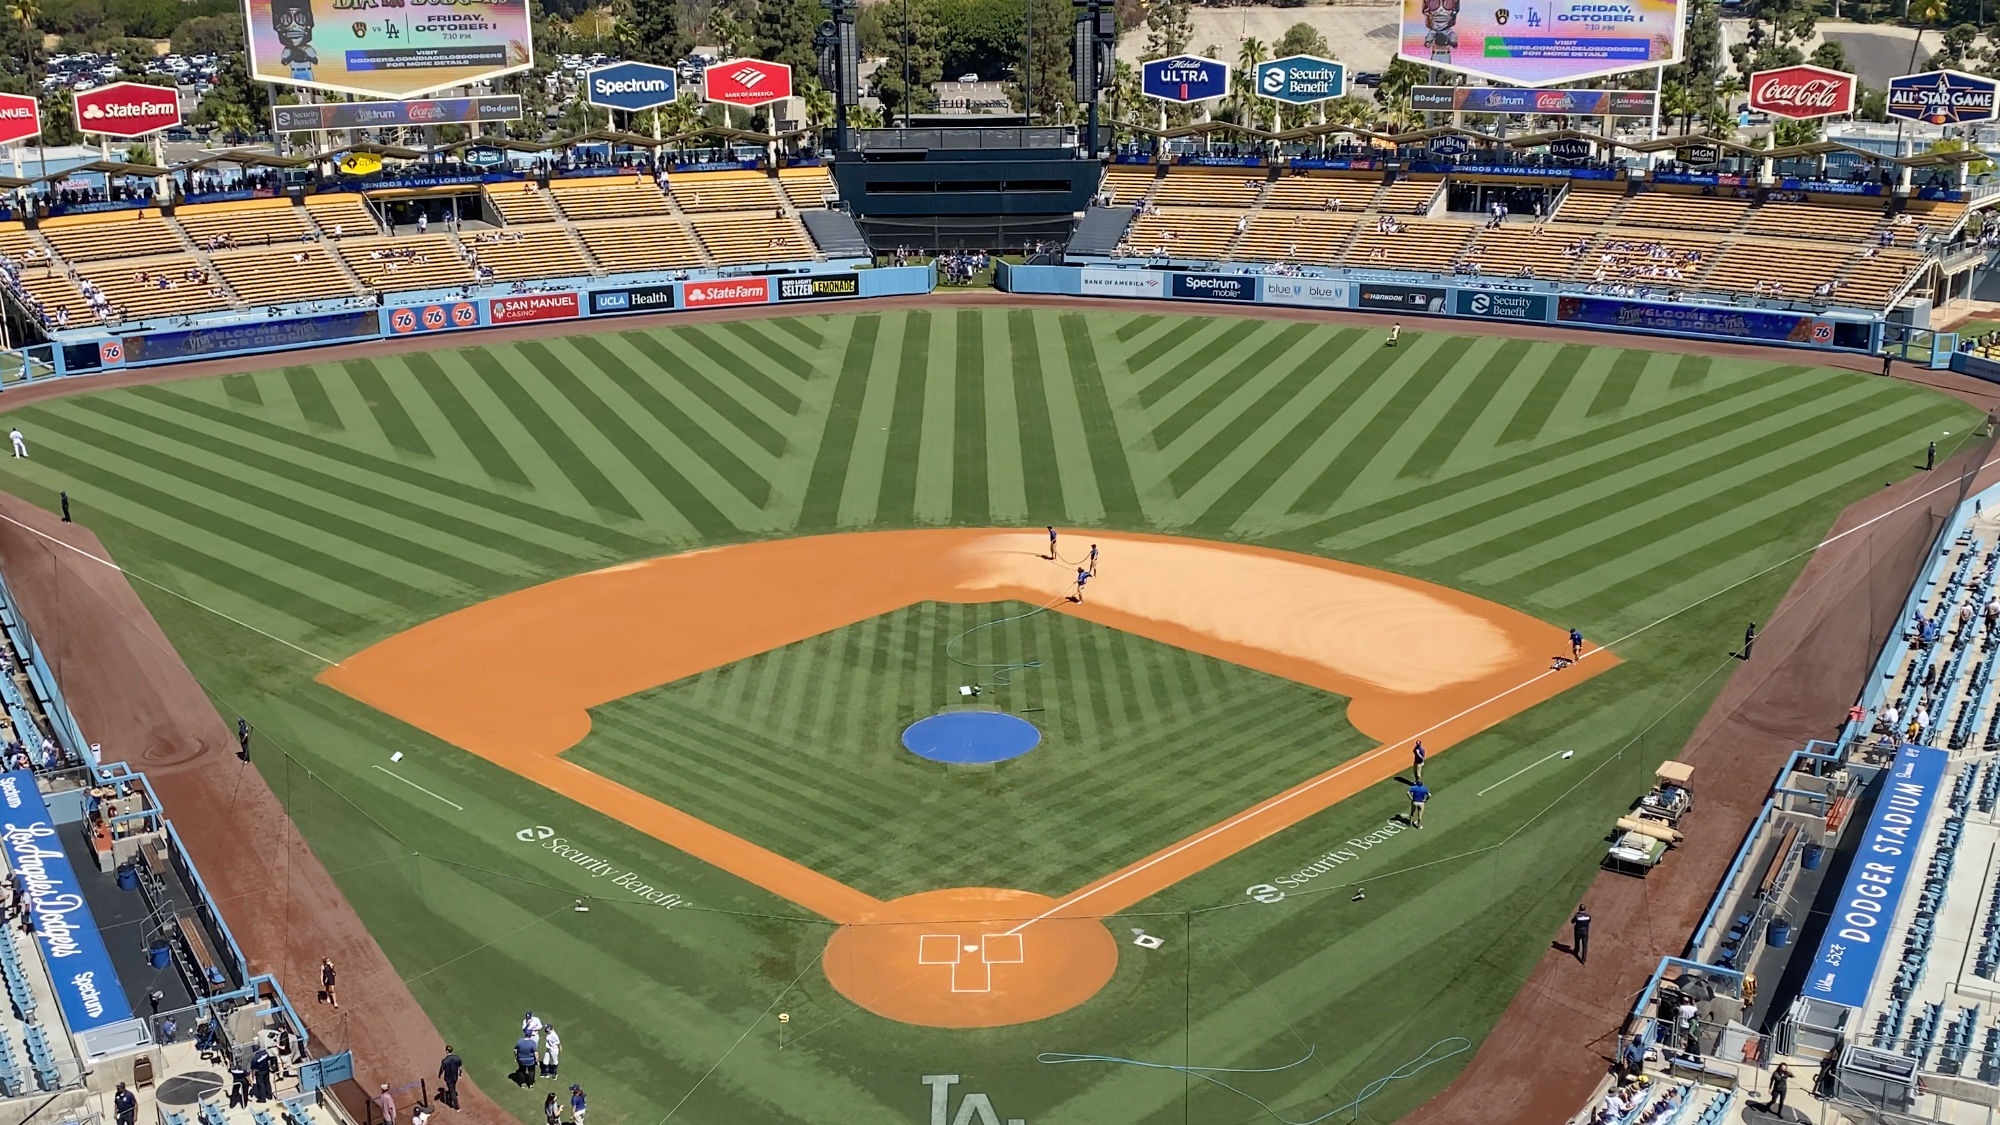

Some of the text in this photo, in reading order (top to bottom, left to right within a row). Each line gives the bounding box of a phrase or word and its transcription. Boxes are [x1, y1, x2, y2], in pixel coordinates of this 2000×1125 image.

[1571, 5, 1631, 14] FRIDAY,
[427, 14, 484, 22] FRIDAY,
[1528, 7, 1541, 27] LA
[1558, 14, 1636, 22] OCTOBER
[385, 19, 399, 38] LA
[415, 24, 488, 32] OCTOBER
[1161, 70, 1209, 82] ULTRA
[1289, 67, 1336, 86] Security
[595, 78, 664, 96] Spectrum
[1289, 80, 1328, 92] Benefit
[1414, 94, 1452, 103] @Dodgers
[1892, 91, 1992, 107] ALL STAR GAME
[480, 104, 518, 113] @Dodgers
[292, 112, 319, 122] Security
[1431, 136, 1466, 152] JIM BEAM
[1553, 144, 1588, 155] DASANI
[1692, 149, 1714, 157] MGM
[414, 178, 436, 186] VIVA
[1186, 276, 1238, 289] Spectrum
[782, 283, 812, 297] SELTZER
[1213, 288, 1237, 297] mobile
[1268, 284, 1291, 294] blue
[1309, 286, 1332, 296] blue
[506, 297, 575, 311] SAN MANUEL
[600, 292, 667, 306] UCLA Health
[1494, 296, 1531, 309] Security
[427, 311, 442, 323] 76
[456, 308, 472, 320] 76
[507, 310, 534, 318] CASINO
[1494, 306, 1525, 317] Benefit
[397, 315, 412, 327] 76
[1648, 318, 1676, 327] LOS
[1814, 327, 1830, 339] 76
[220, 338, 248, 347] LOS
[104, 346, 120, 359] 76
[0, 777, 20, 808] Spectrum
[15, 840, 64, 898] Angeles
[1275, 847, 1360, 889] Security
[1839, 783, 1925, 943] DODGER STADIUM
[542, 837, 685, 910] Security Benefit
[33, 893, 83, 958] Dodgers
[1825, 943, 1847, 967] ようこそ
[72, 971, 103, 1017] Spectrum
